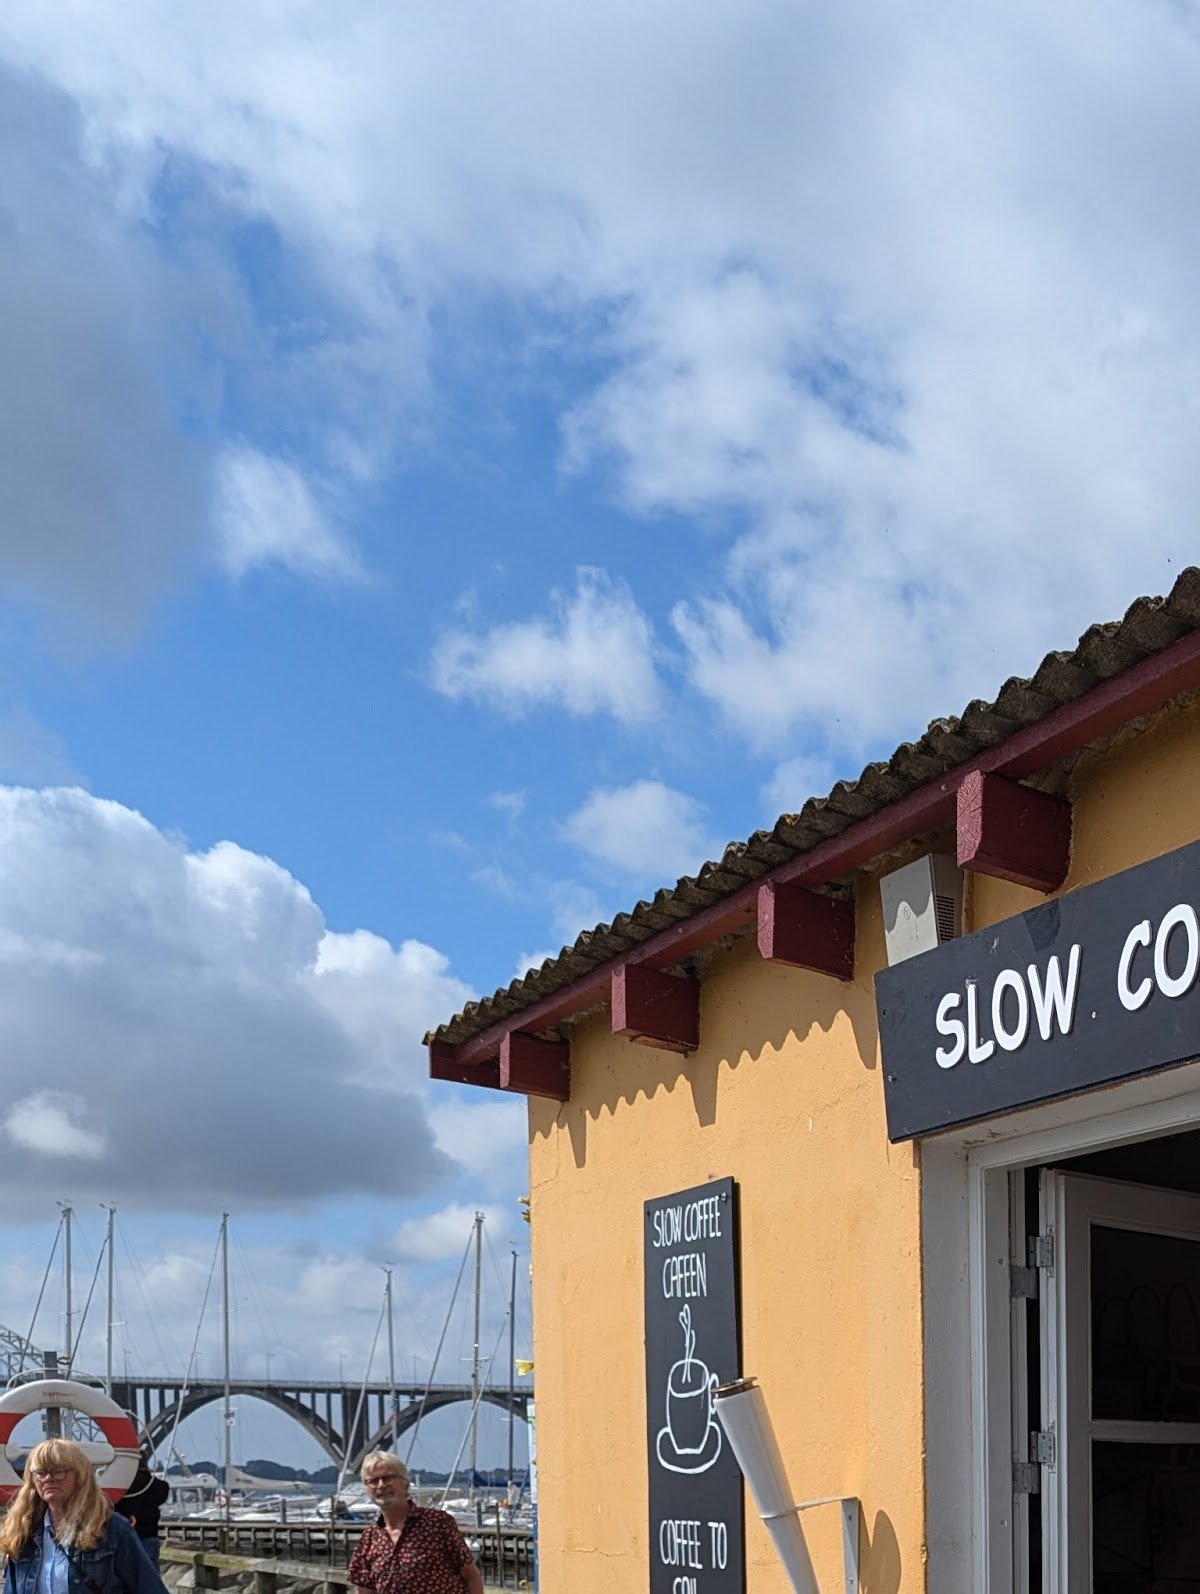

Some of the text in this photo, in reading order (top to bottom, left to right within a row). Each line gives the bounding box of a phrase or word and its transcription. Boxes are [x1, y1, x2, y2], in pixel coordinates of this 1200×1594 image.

[935, 943, 1081, 1069] SLOW
[652, 1194, 722, 1248] SLOW COFFEE
[662, 1252, 707, 1299] CAFEEN
[659, 1519, 728, 1570] COFFEE TO
